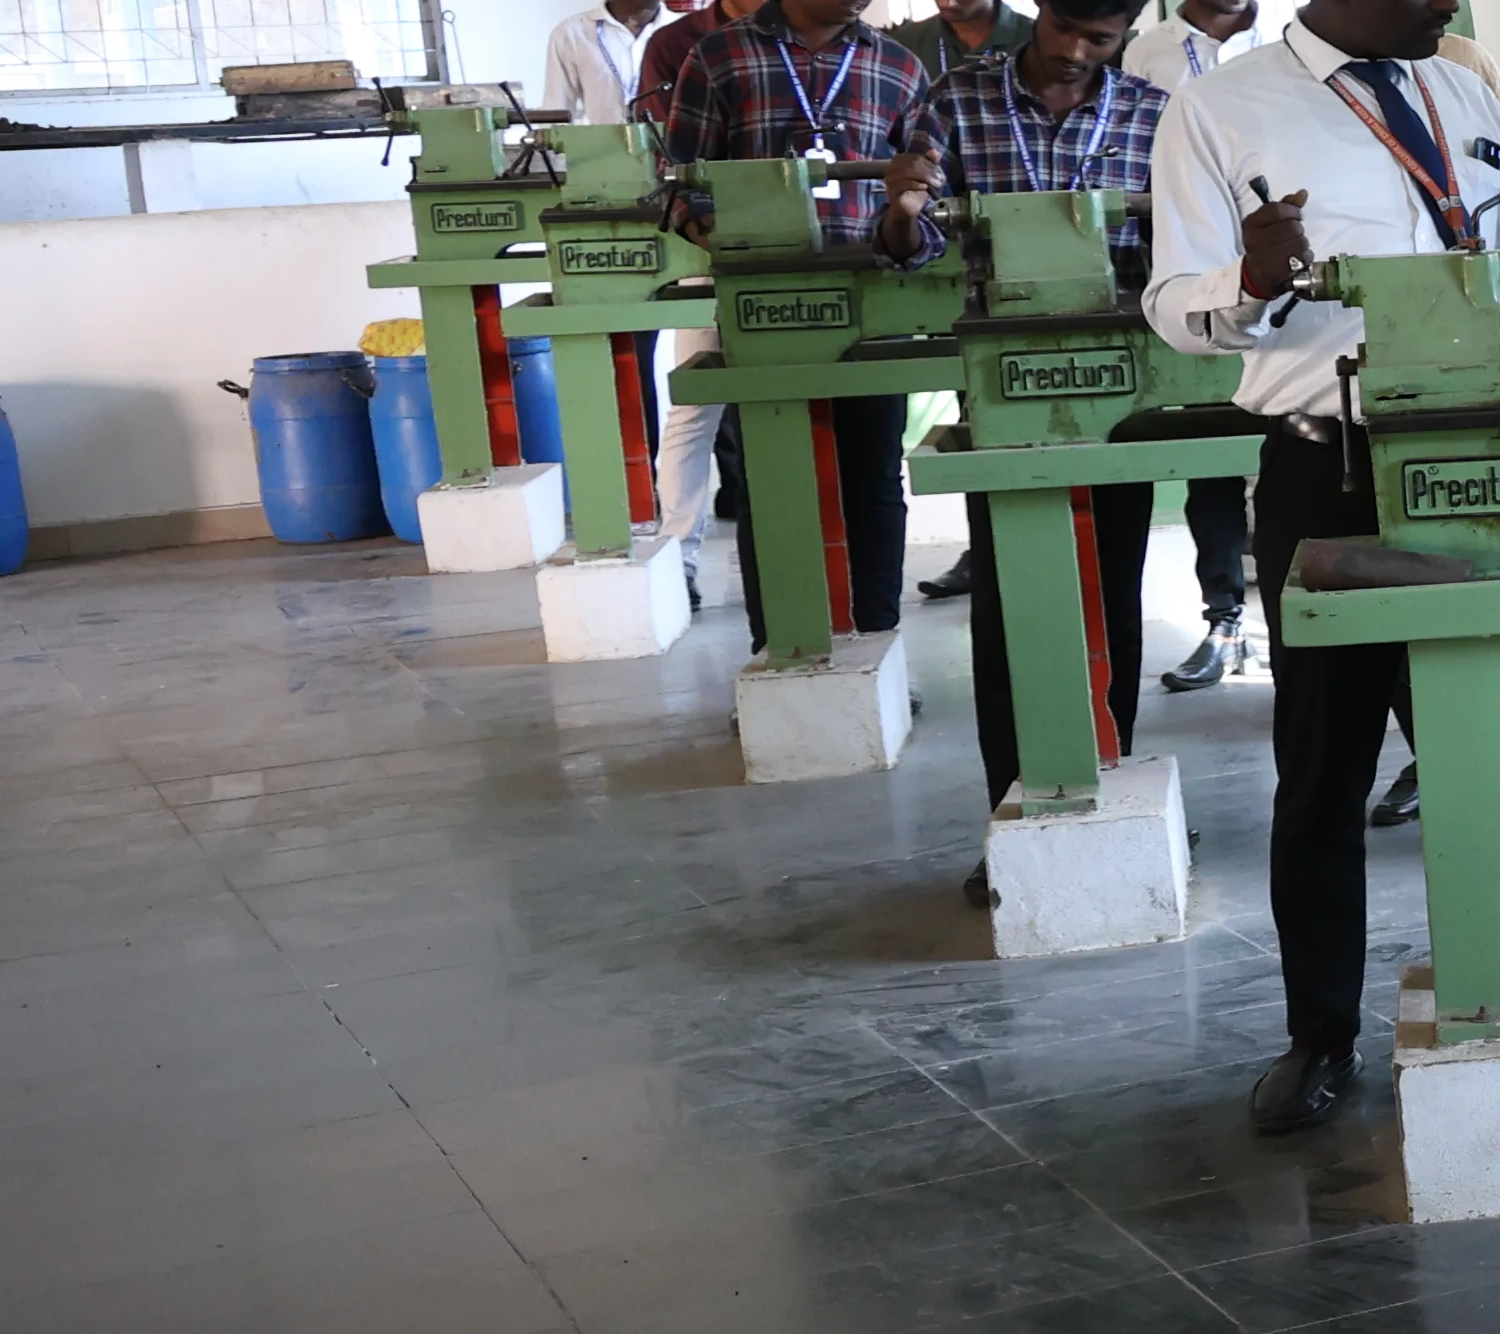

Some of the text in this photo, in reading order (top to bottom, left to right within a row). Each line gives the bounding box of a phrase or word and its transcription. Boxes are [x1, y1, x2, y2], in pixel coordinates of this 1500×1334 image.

[565, 245, 653, 268] Preciturn
[743, 297, 844, 324] Preciturn
[1007, 357, 1125, 392] Preciturn
